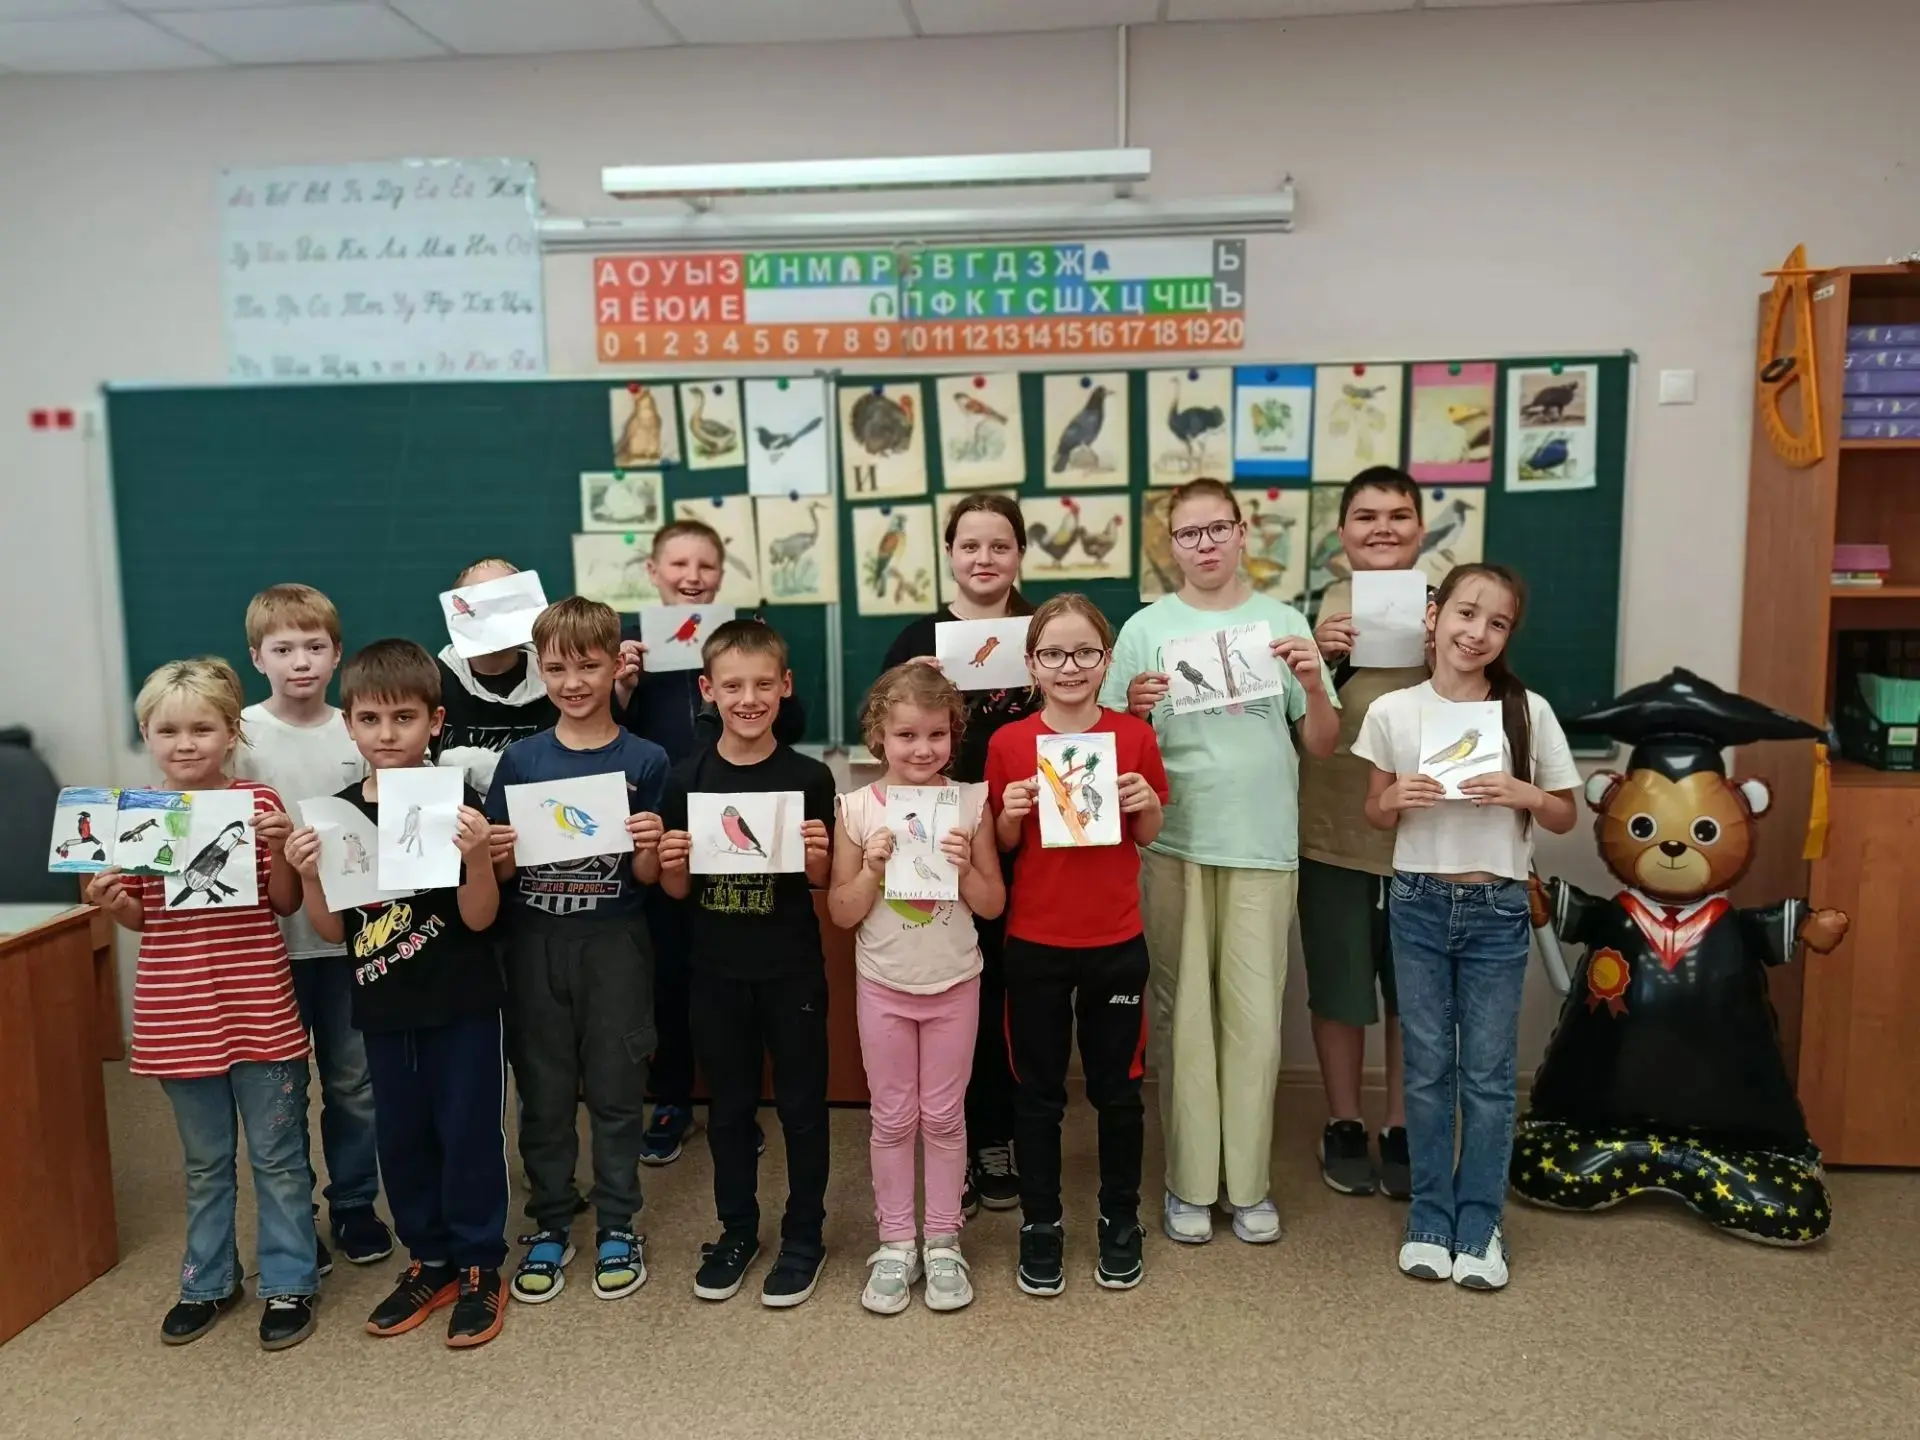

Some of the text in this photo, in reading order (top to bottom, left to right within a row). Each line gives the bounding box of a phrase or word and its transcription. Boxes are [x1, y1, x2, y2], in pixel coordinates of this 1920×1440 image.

[599, 262, 620, 286] А
[627, 261, 651, 286] О
[660, 260, 679, 286] У
[685, 260, 712, 285] Ы
[719, 259, 740, 285] Э
[779, 258, 799, 283] Н
[808, 257, 831, 283] М
[871, 256, 891, 281] Р
[933, 254, 954, 280] В
[966, 253, 984, 279] Г
[993, 251, 1017, 283] Д
[1027, 251, 1047, 278] З
[1054, 250, 1084, 276] Ж
[1218, 245, 1240, 271] Ь
[600, 298, 620, 323] Я
[631, 291, 649, 323] Ё
[655, 297, 684, 323] Ю
[690, 296, 711, 321] И
[720, 295, 741, 320] Е
[930, 289, 956, 316] Ф
[965, 289, 985, 315] К
[998, 288, 1015, 314] Т
[1026, 288, 1048, 315] С
[1054, 287, 1083, 314] Ш
[1090, 286, 1111, 313] Х
[1121, 285, 1144, 315] Ц
[1153, 284, 1174, 310] Ч
[1179, 283, 1213, 313] Щ
[1214, 283, 1241, 309] Ъ
[603, 333, 619, 357] 0
[634, 332, 647, 356] 1
[663, 331, 679, 356] 2
[694, 331, 709, 355] 3
[722, 330, 740, 354] 4
[753, 329, 770, 354] 5
[783, 329, 800, 353] 6
[813, 328, 830, 353] 7
[843, 328, 860, 353] 8
[873, 327, 891, 352] 9
[931, 325, 954, 350] 11
[961, 325, 988, 350] 12
[995, 324, 1020, 349] 13
[1024, 323, 1051, 348] 14
[1057, 322, 1084, 348] 15
[1086, 321, 1115, 347] 16
[1118, 320, 1145, 347] 17
[1150, 320, 1178, 346] 18
[1182, 319, 1209, 345] 19
[1212, 318, 1244, 344] 20
[853, 465, 878, 492] И
